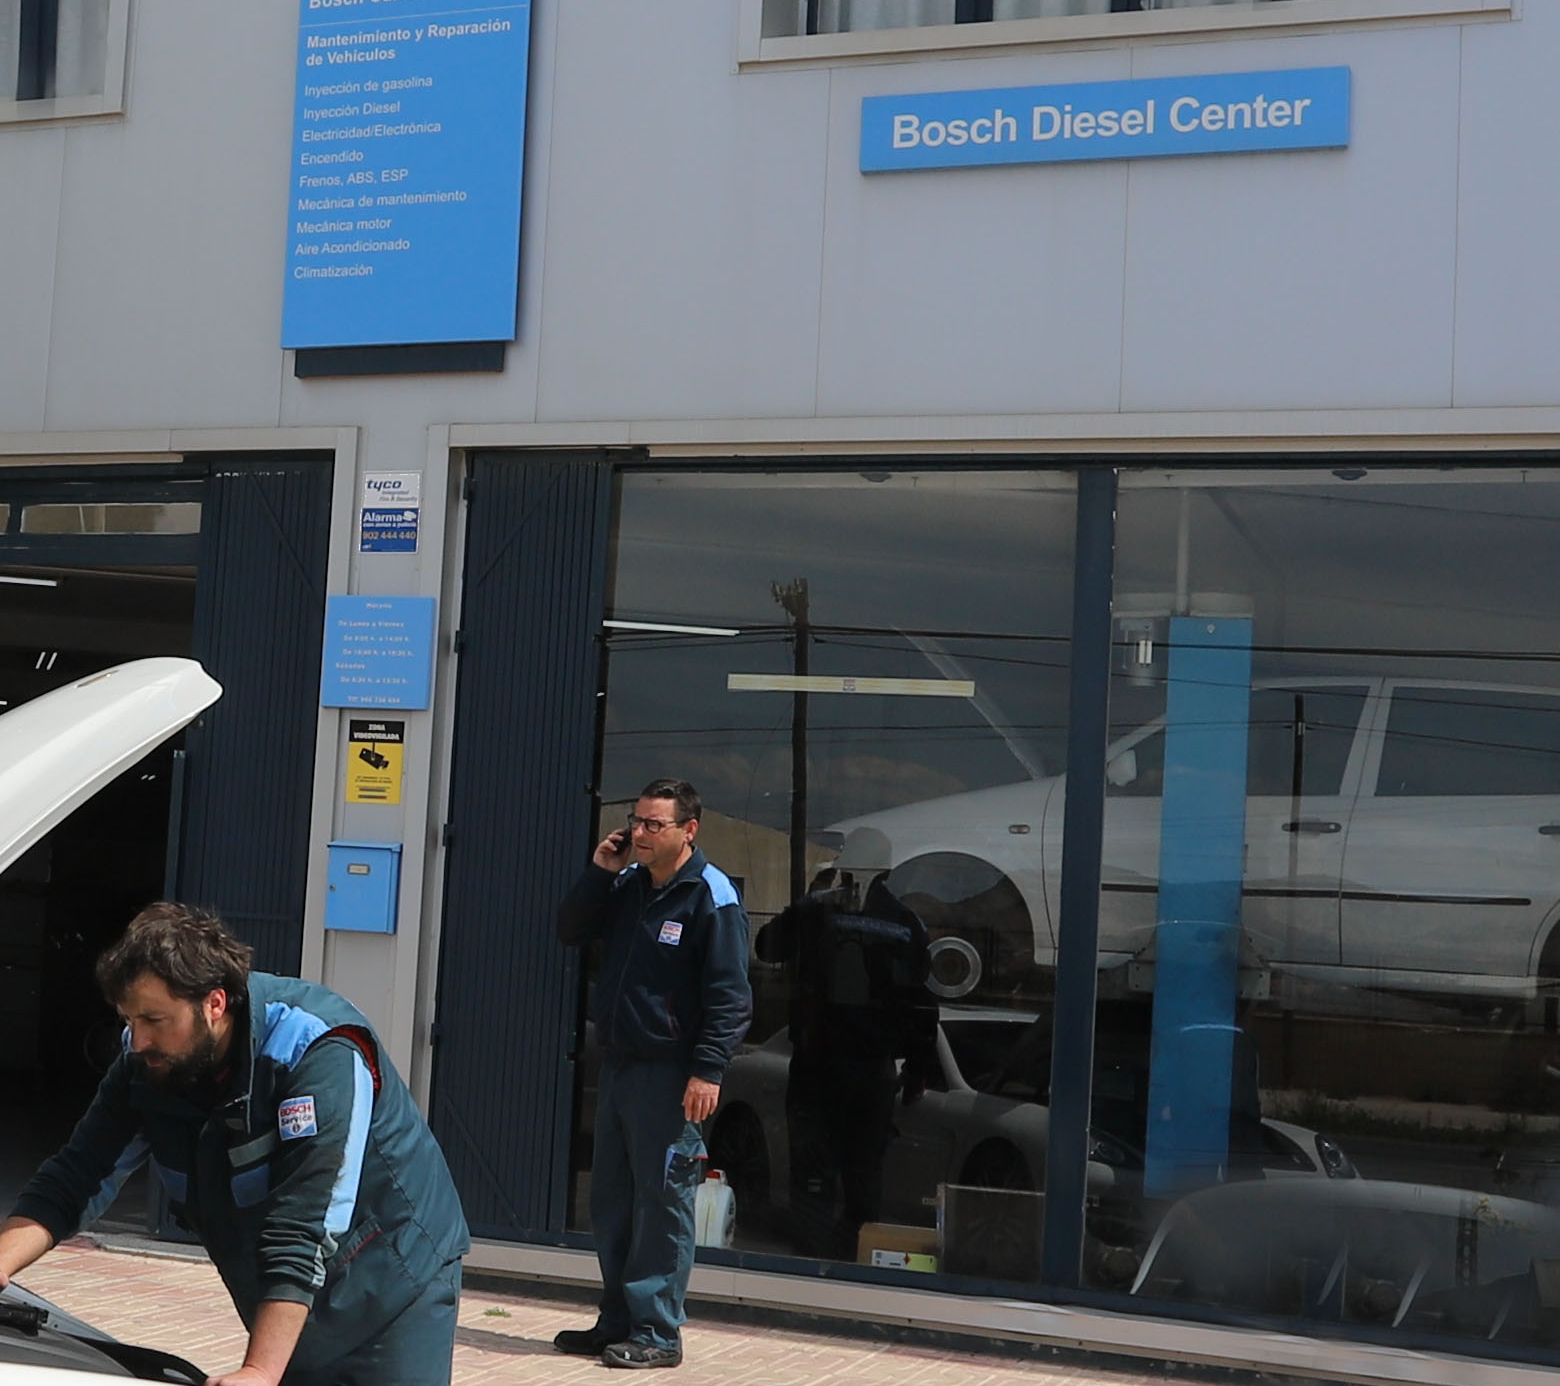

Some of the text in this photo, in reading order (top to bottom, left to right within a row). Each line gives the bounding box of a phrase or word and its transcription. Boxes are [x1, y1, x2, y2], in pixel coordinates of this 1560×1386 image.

[307, 18, 511, 48] Mantenimiento y Reparación
[307, 53, 323, 66] de
[305, 76, 433, 98] Inyección de gasolina
[304, 101, 400, 121] Inyección Diesel
[892, 94, 1310, 149] Bosch Diesel Center
[301, 150, 364, 165] Encendido
[299, 169, 408, 187] Frenos, ABS, ESP
[298, 190, 467, 211] Mecánica de mantenimiento
[297, 218, 392, 233] Mecánica motor
[295, 239, 410, 255] Aire Acondicionado
[294, 264, 373, 279] Climatización
[367, 480, 402, 491] tyco
[364, 512, 402, 522] Alarma
